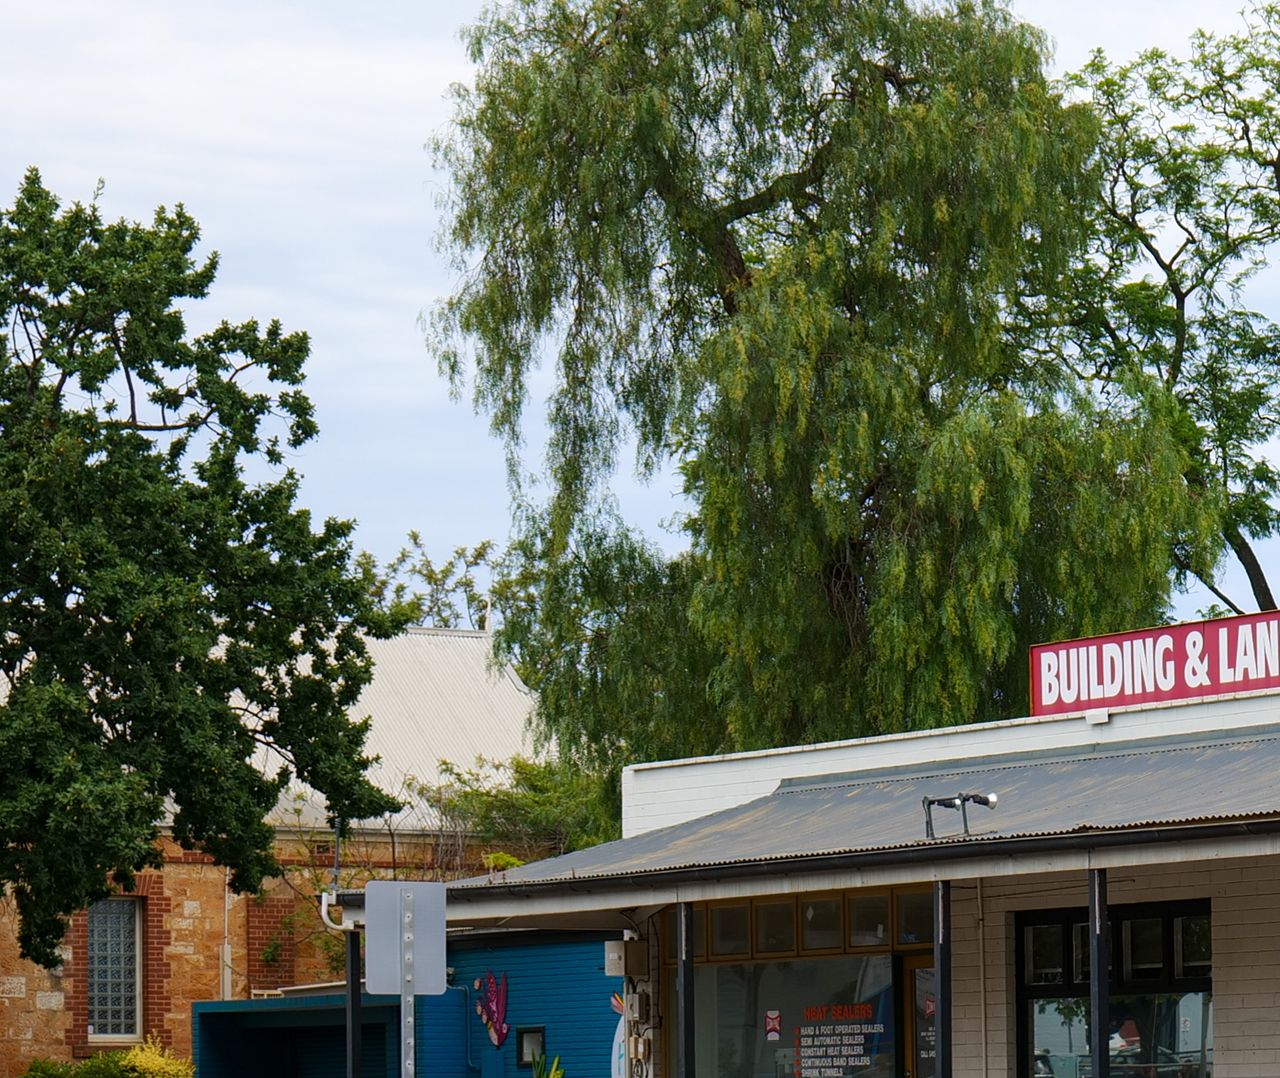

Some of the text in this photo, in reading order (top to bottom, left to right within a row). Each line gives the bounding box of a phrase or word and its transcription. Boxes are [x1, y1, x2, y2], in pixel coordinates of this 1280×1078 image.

[1040, 634, 1175, 706] BUILDING
[1184, 631, 1210, 688] &
[804, 1004, 872, 1020] HEAT SEALERS
[801, 1026, 815, 1036] HAND
[821, 1025, 834, 1034] FOOT
[835, 1024, 861, 1034] OPERATED
[862, 1023, 884, 1033] SEALERS
[801, 1035, 865, 1046] SEMI AUTOMATIC SEALERS
[801, 1045, 864, 1056] CONSTANT HEAT SEALERS
[801, 1056, 871, 1067] CONTINUOUS BAND SEALERS
[801, 1068, 843, 1077] SHRINK TUNNELS
